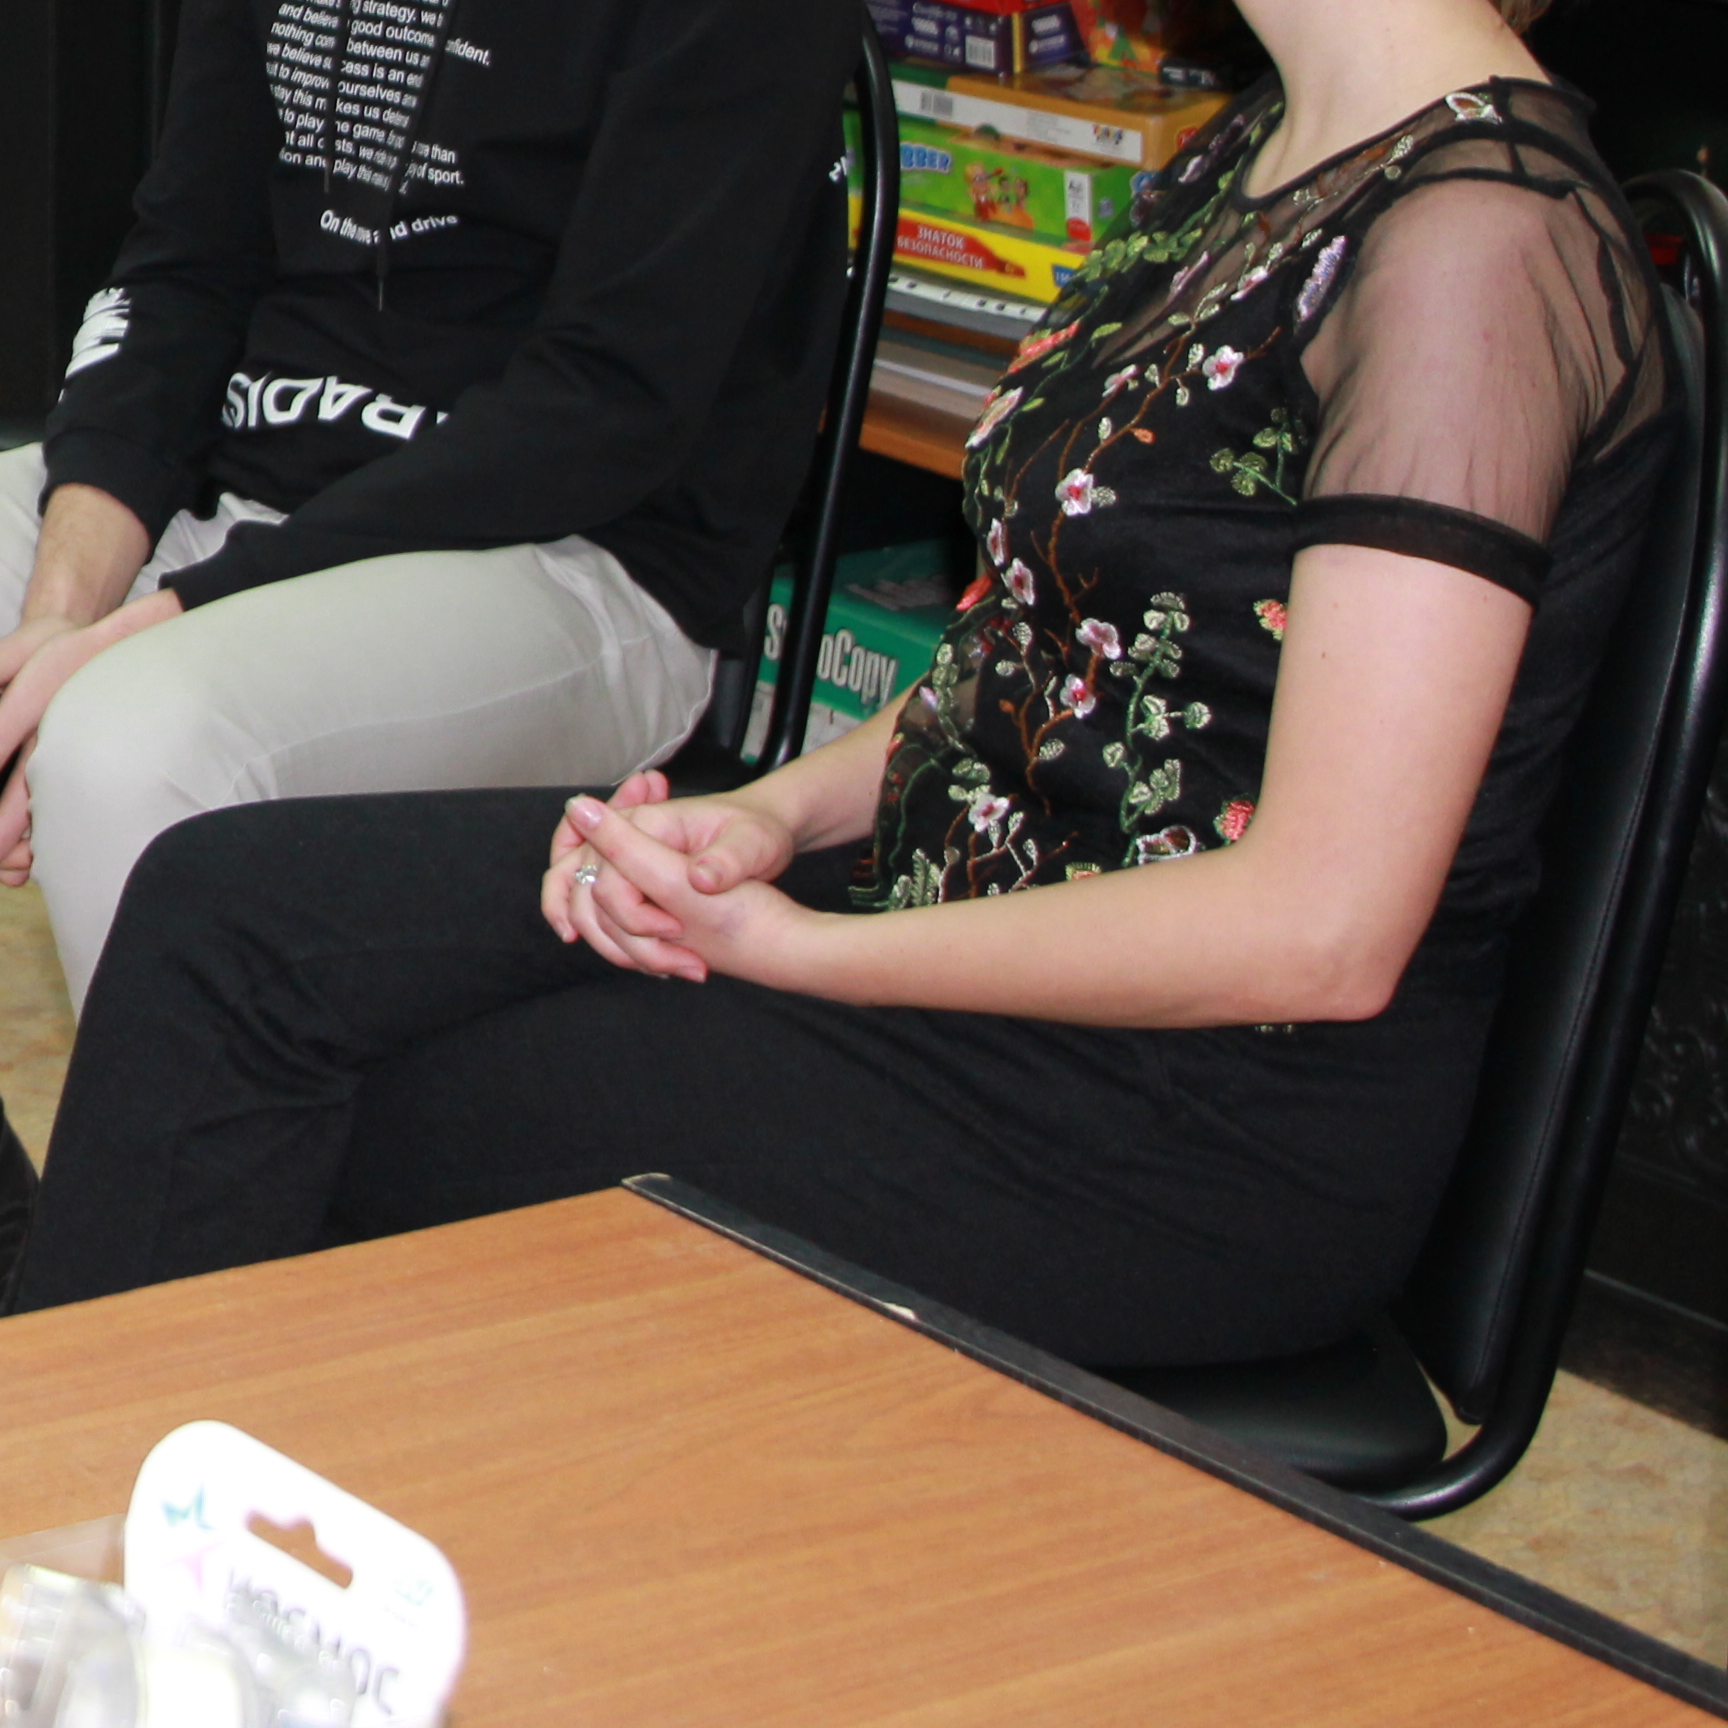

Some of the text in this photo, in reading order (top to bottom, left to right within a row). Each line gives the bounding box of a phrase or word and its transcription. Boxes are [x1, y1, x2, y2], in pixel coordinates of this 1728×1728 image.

[278, 3, 304, 21] and
[351, 19, 383, 35] good
[362, 0, 416, 24] strategy.
[271, 22, 315, 47] nothing
[346, 37, 402, 61] between
[405, 51, 420, 66] us
[282, 43, 322, 67] believe
[373, 63, 384, 79] is
[388, 69, 404, 83] an
[279, 63, 290, 79] to
[291, 66, 329, 89] improv
[338, 80, 401, 104] ourselves
[293, 89, 313, 106] this
[315, 97, 360, 116] mkes
[364, 105, 380, 120] us
[296, 112, 324, 133] play
[353, 123, 385, 142] game
[431, 143, 456, 165] than
[298, 133, 314, 148] all
[428, 167, 464, 186] sport.
[333, 158, 357, 181] play
[320, 209, 340, 232] On
[411, 215, 458, 233] drive
[917, 225, 965, 250] ЗНАТОК
[897, 235, 983, 269] БЕЗОПАСНОСТИ
